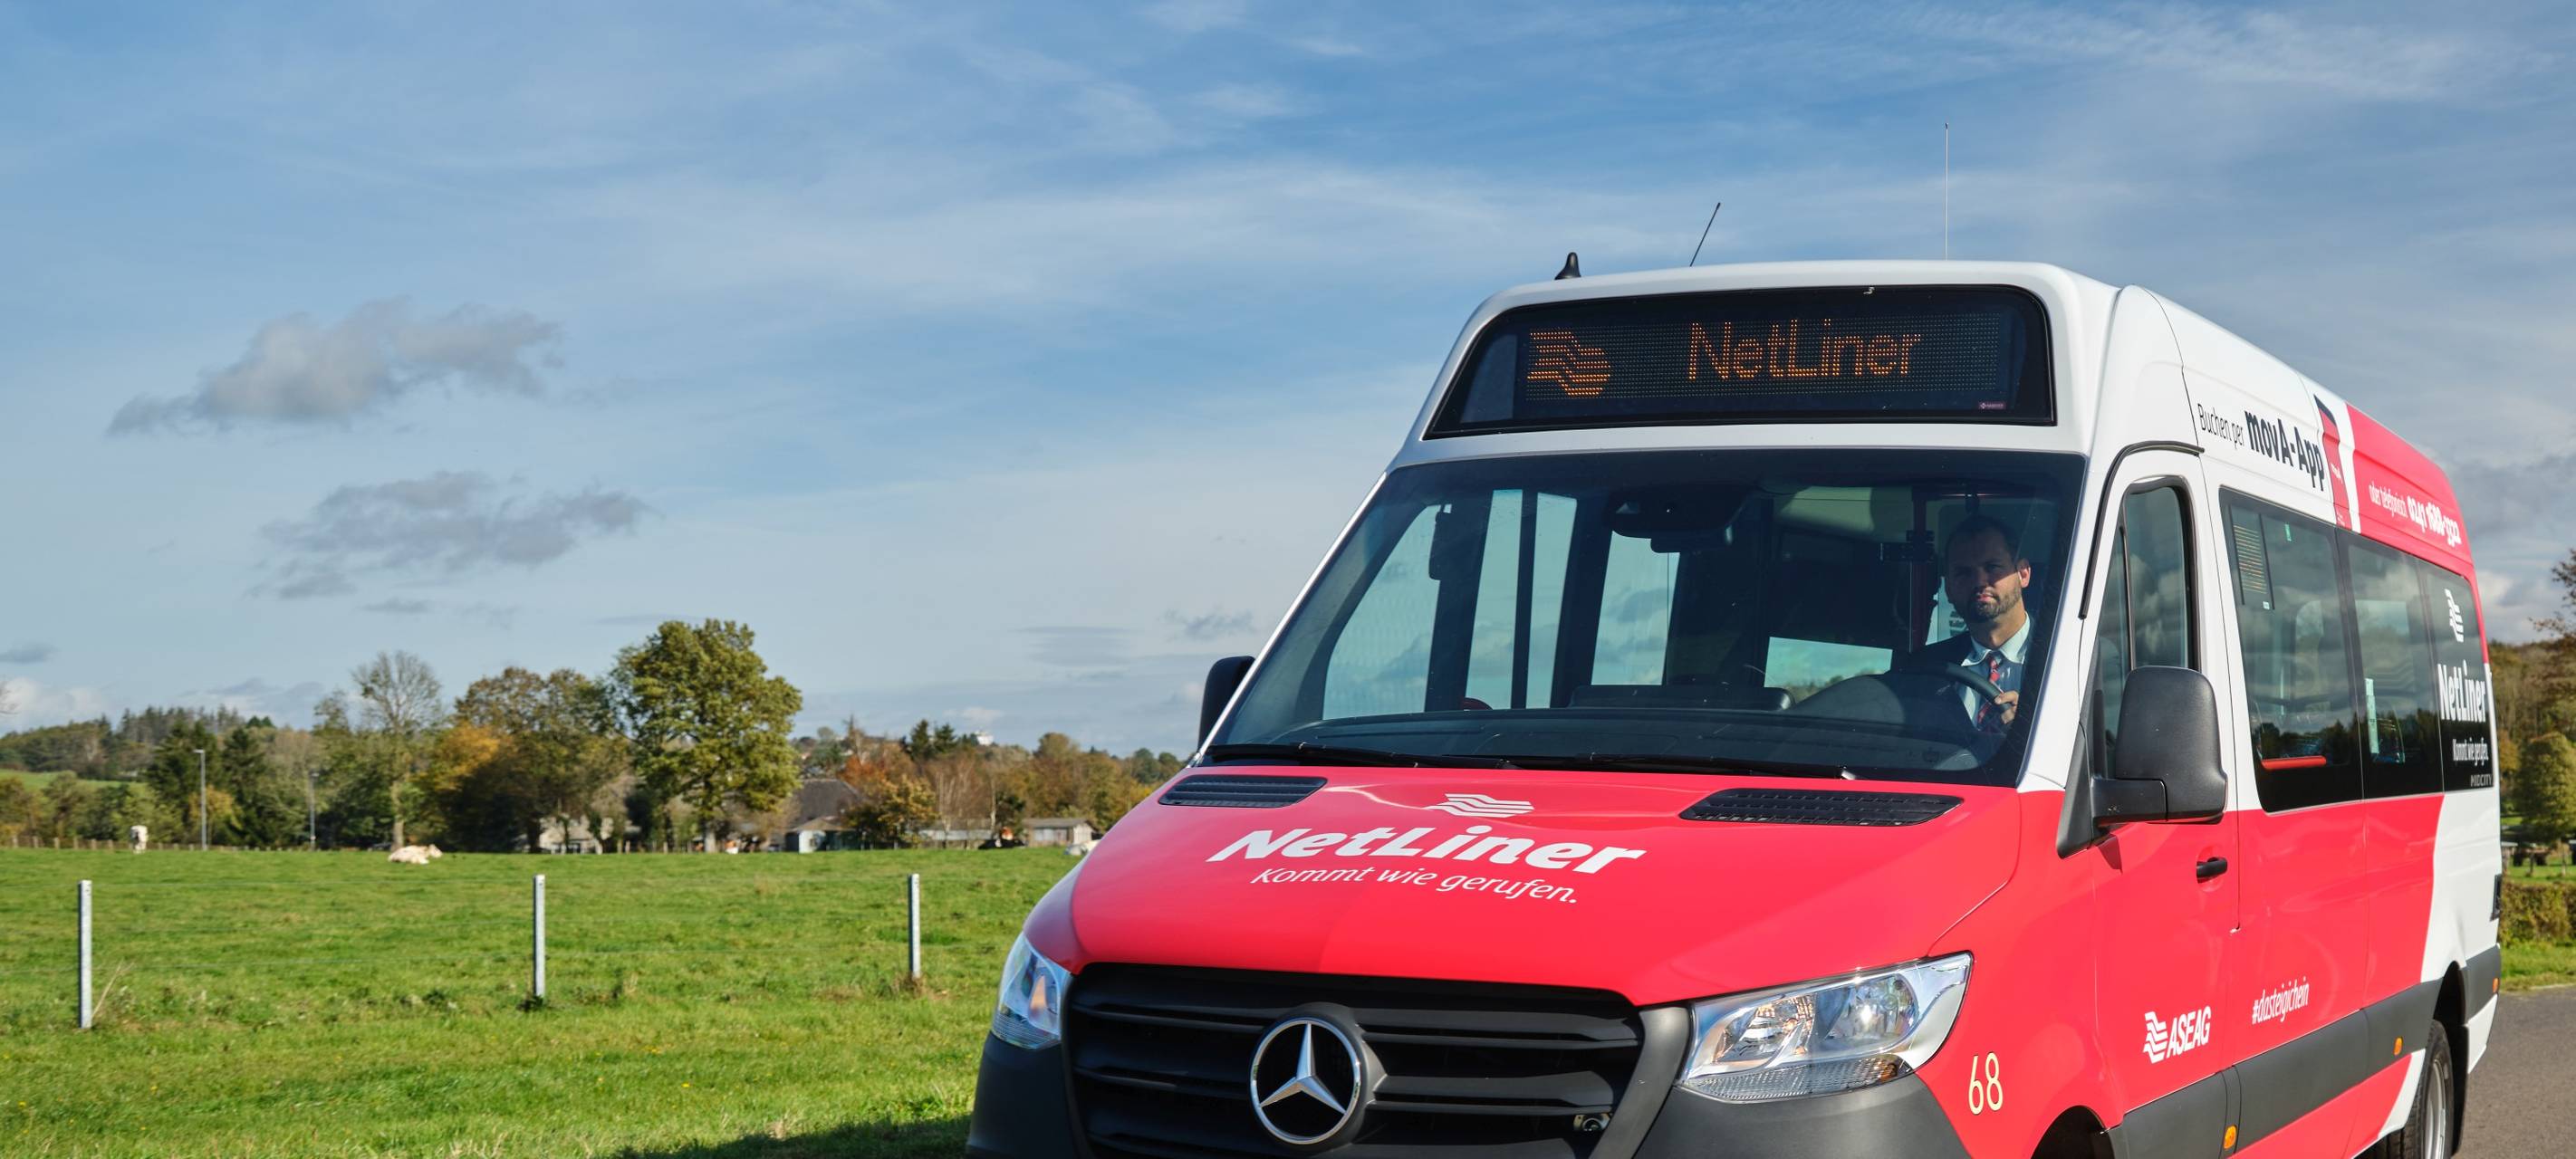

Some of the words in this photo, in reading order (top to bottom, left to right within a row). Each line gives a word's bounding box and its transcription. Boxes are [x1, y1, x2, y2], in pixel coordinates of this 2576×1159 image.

[1688, 319, 1920, 381] NetLiner
[2197, 403, 2232, 441] Buchen
[2232, 423, 2245, 448] per
[2244, 410, 2325, 491] movA-App
[2437, 659, 2486, 723] NetLiner
[1206, 825, 1648, 874] NetLiner
[1250, 867, 1376, 885] Kommt
[1377, 869, 1437, 886] wie
[1437, 874, 1577, 904] gerufen.
[2252, 977, 2310, 1025] #dasteigichein
[2166, 1005, 2211, 1058] ASEAG
[1968, 1051, 2004, 1115] 68
